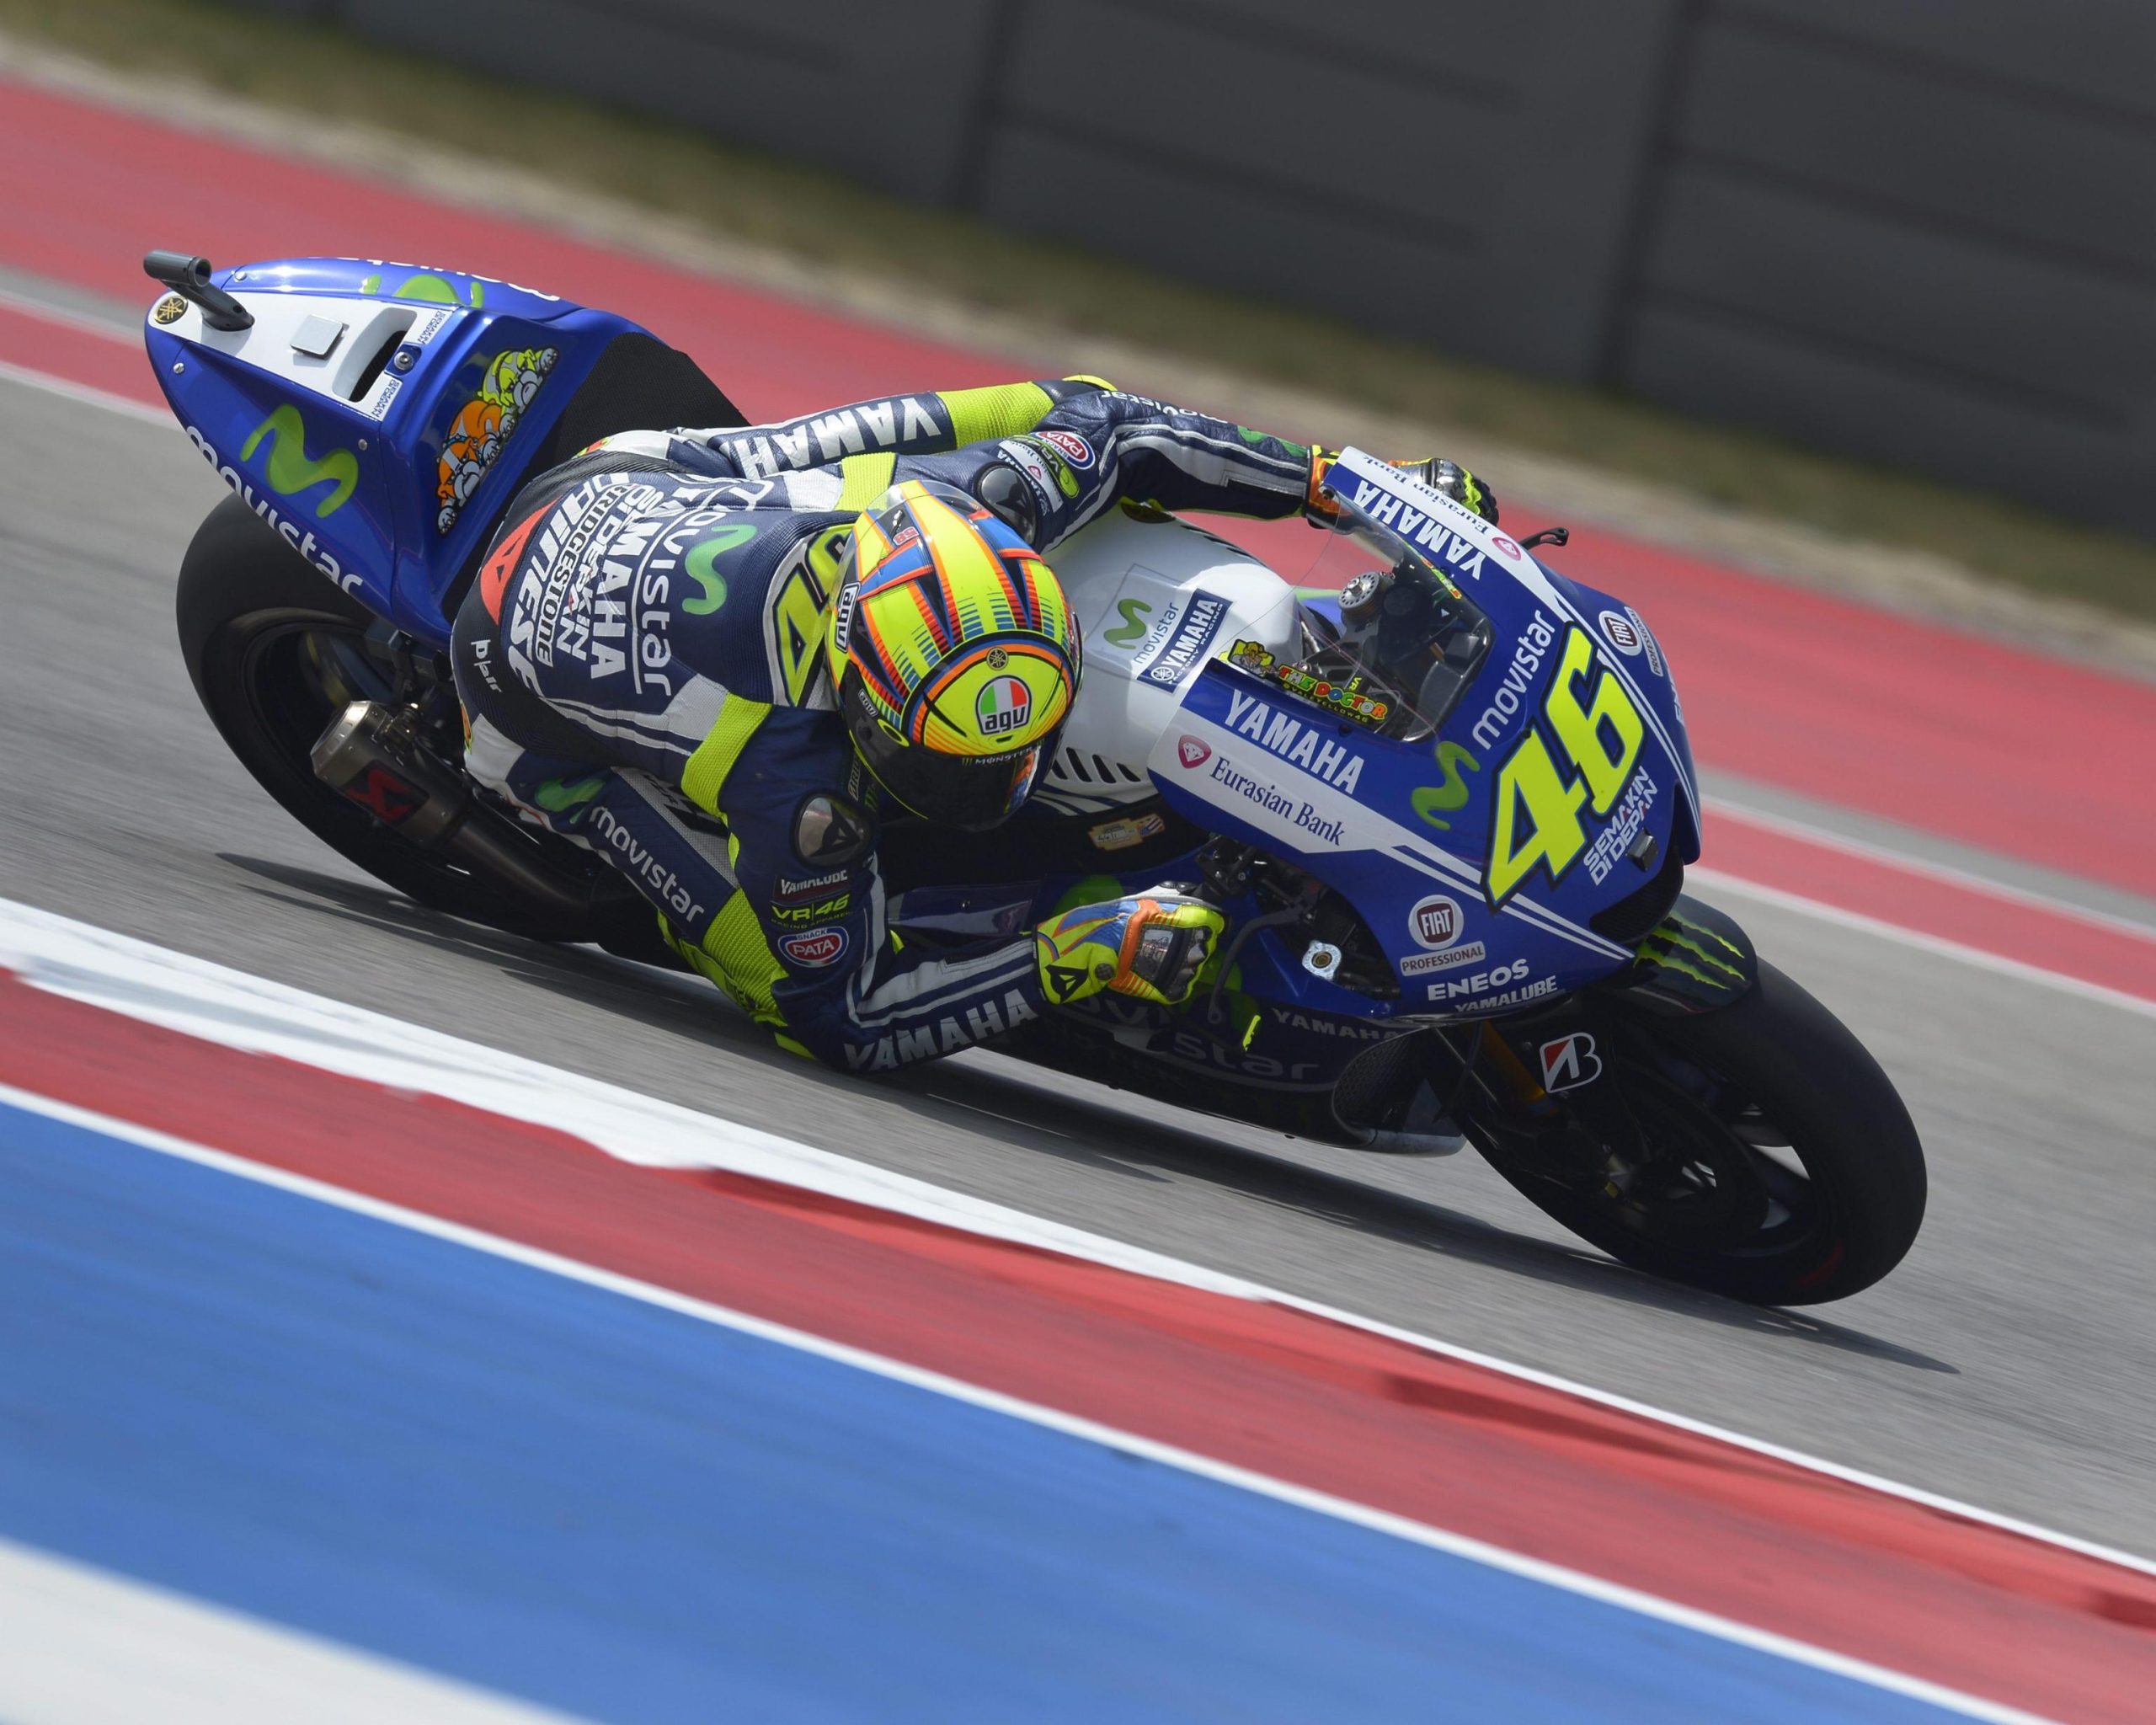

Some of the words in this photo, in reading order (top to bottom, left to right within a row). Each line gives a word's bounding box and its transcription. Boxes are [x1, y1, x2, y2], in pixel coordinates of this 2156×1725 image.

[1354, 480, 1486, 580] YAMAHA
[508, 472, 630, 699] DAINESE
[1134, 602, 1179, 664] movistar
[1161, 599, 1219, 668] YAMAHA
[1608, 617, 1635, 645] FIAT
[1279, 664, 1319, 692] THE
[1313, 681, 1388, 720] DOCTOR
[1471, 609, 1556, 750] movistar
[985, 707, 1026, 731] agv
[1224, 688, 1365, 794] YAMAHA
[1209, 756, 1294, 820] Eurasian
[1293, 802, 1345, 846] Bank
[1486, 625, 1646, 905] 46
[1583, 765, 1649, 873] SEMAKIN
[1609, 778, 1658, 862] DEPAN
[590, 805, 704, 923] movistar
[792, 939, 835, 956] PATA
[1401, 945, 1484, 973] PROFESSIONAL
[1421, 909, 1452, 937] FIAT
[1428, 958, 1529, 1001] ENEOS
[1454, 975, 1558, 1012] YAMALUBE
[846, 988, 1038, 1071] YAMAHA
